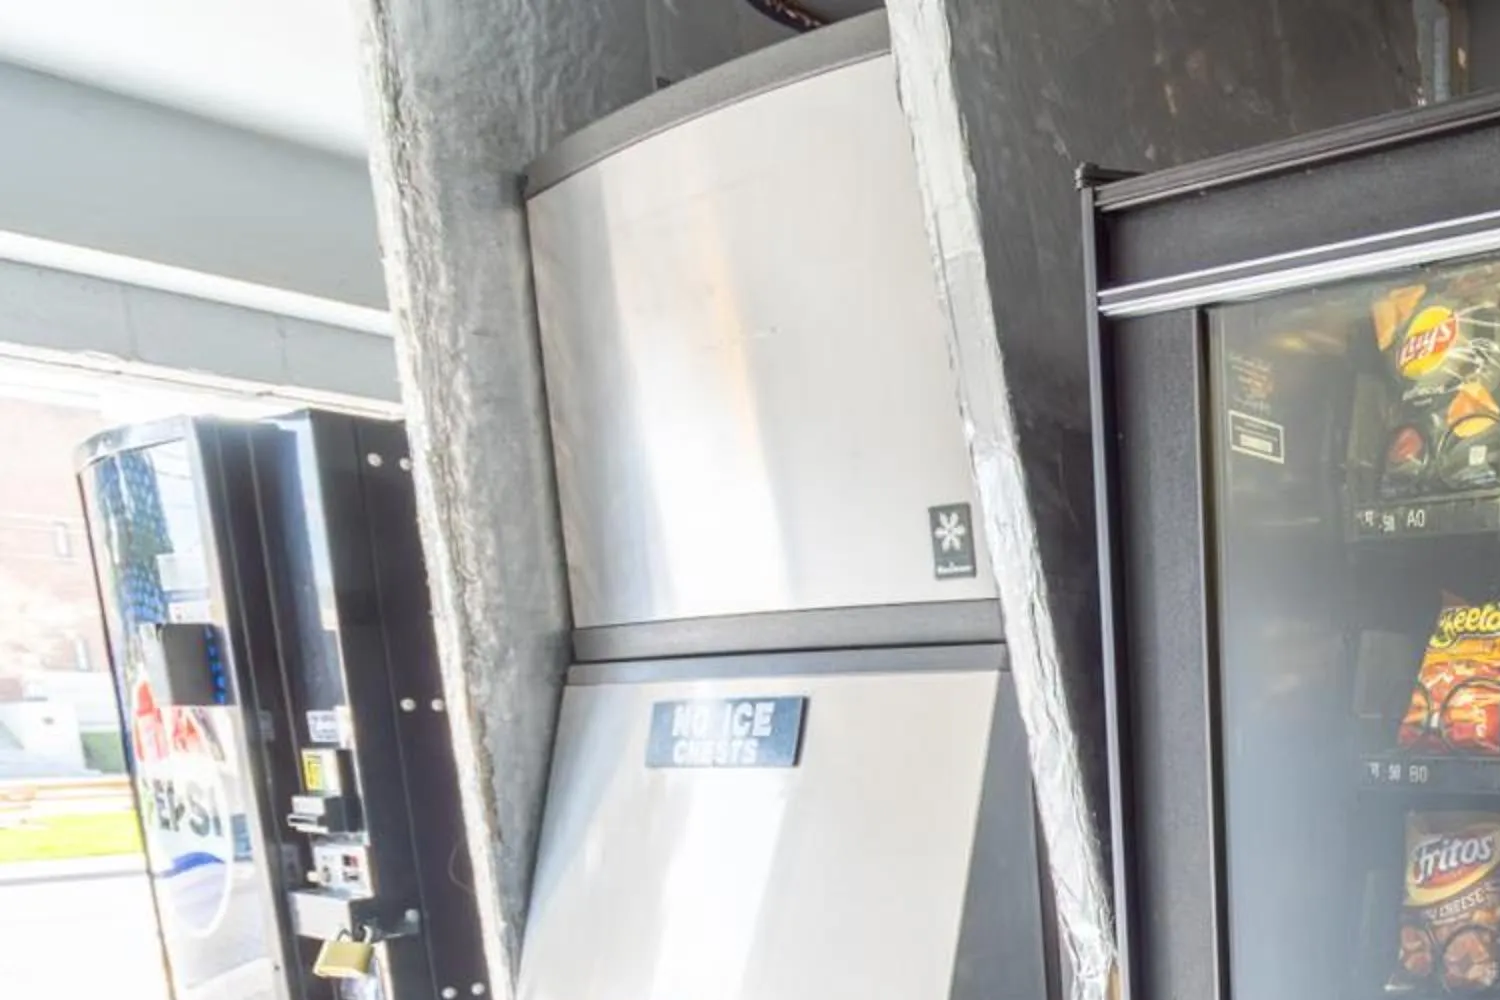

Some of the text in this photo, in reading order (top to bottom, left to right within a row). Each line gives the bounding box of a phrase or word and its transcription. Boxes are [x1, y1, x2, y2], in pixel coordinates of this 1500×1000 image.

[1406, 509, 1425, 527] A0
[672, 701, 775, 737] NO ICE
[673, 738, 759, 764] CHESTS
[1409, 765, 1428, 784] B0
[1415, 834, 1494, 882] Fritos
